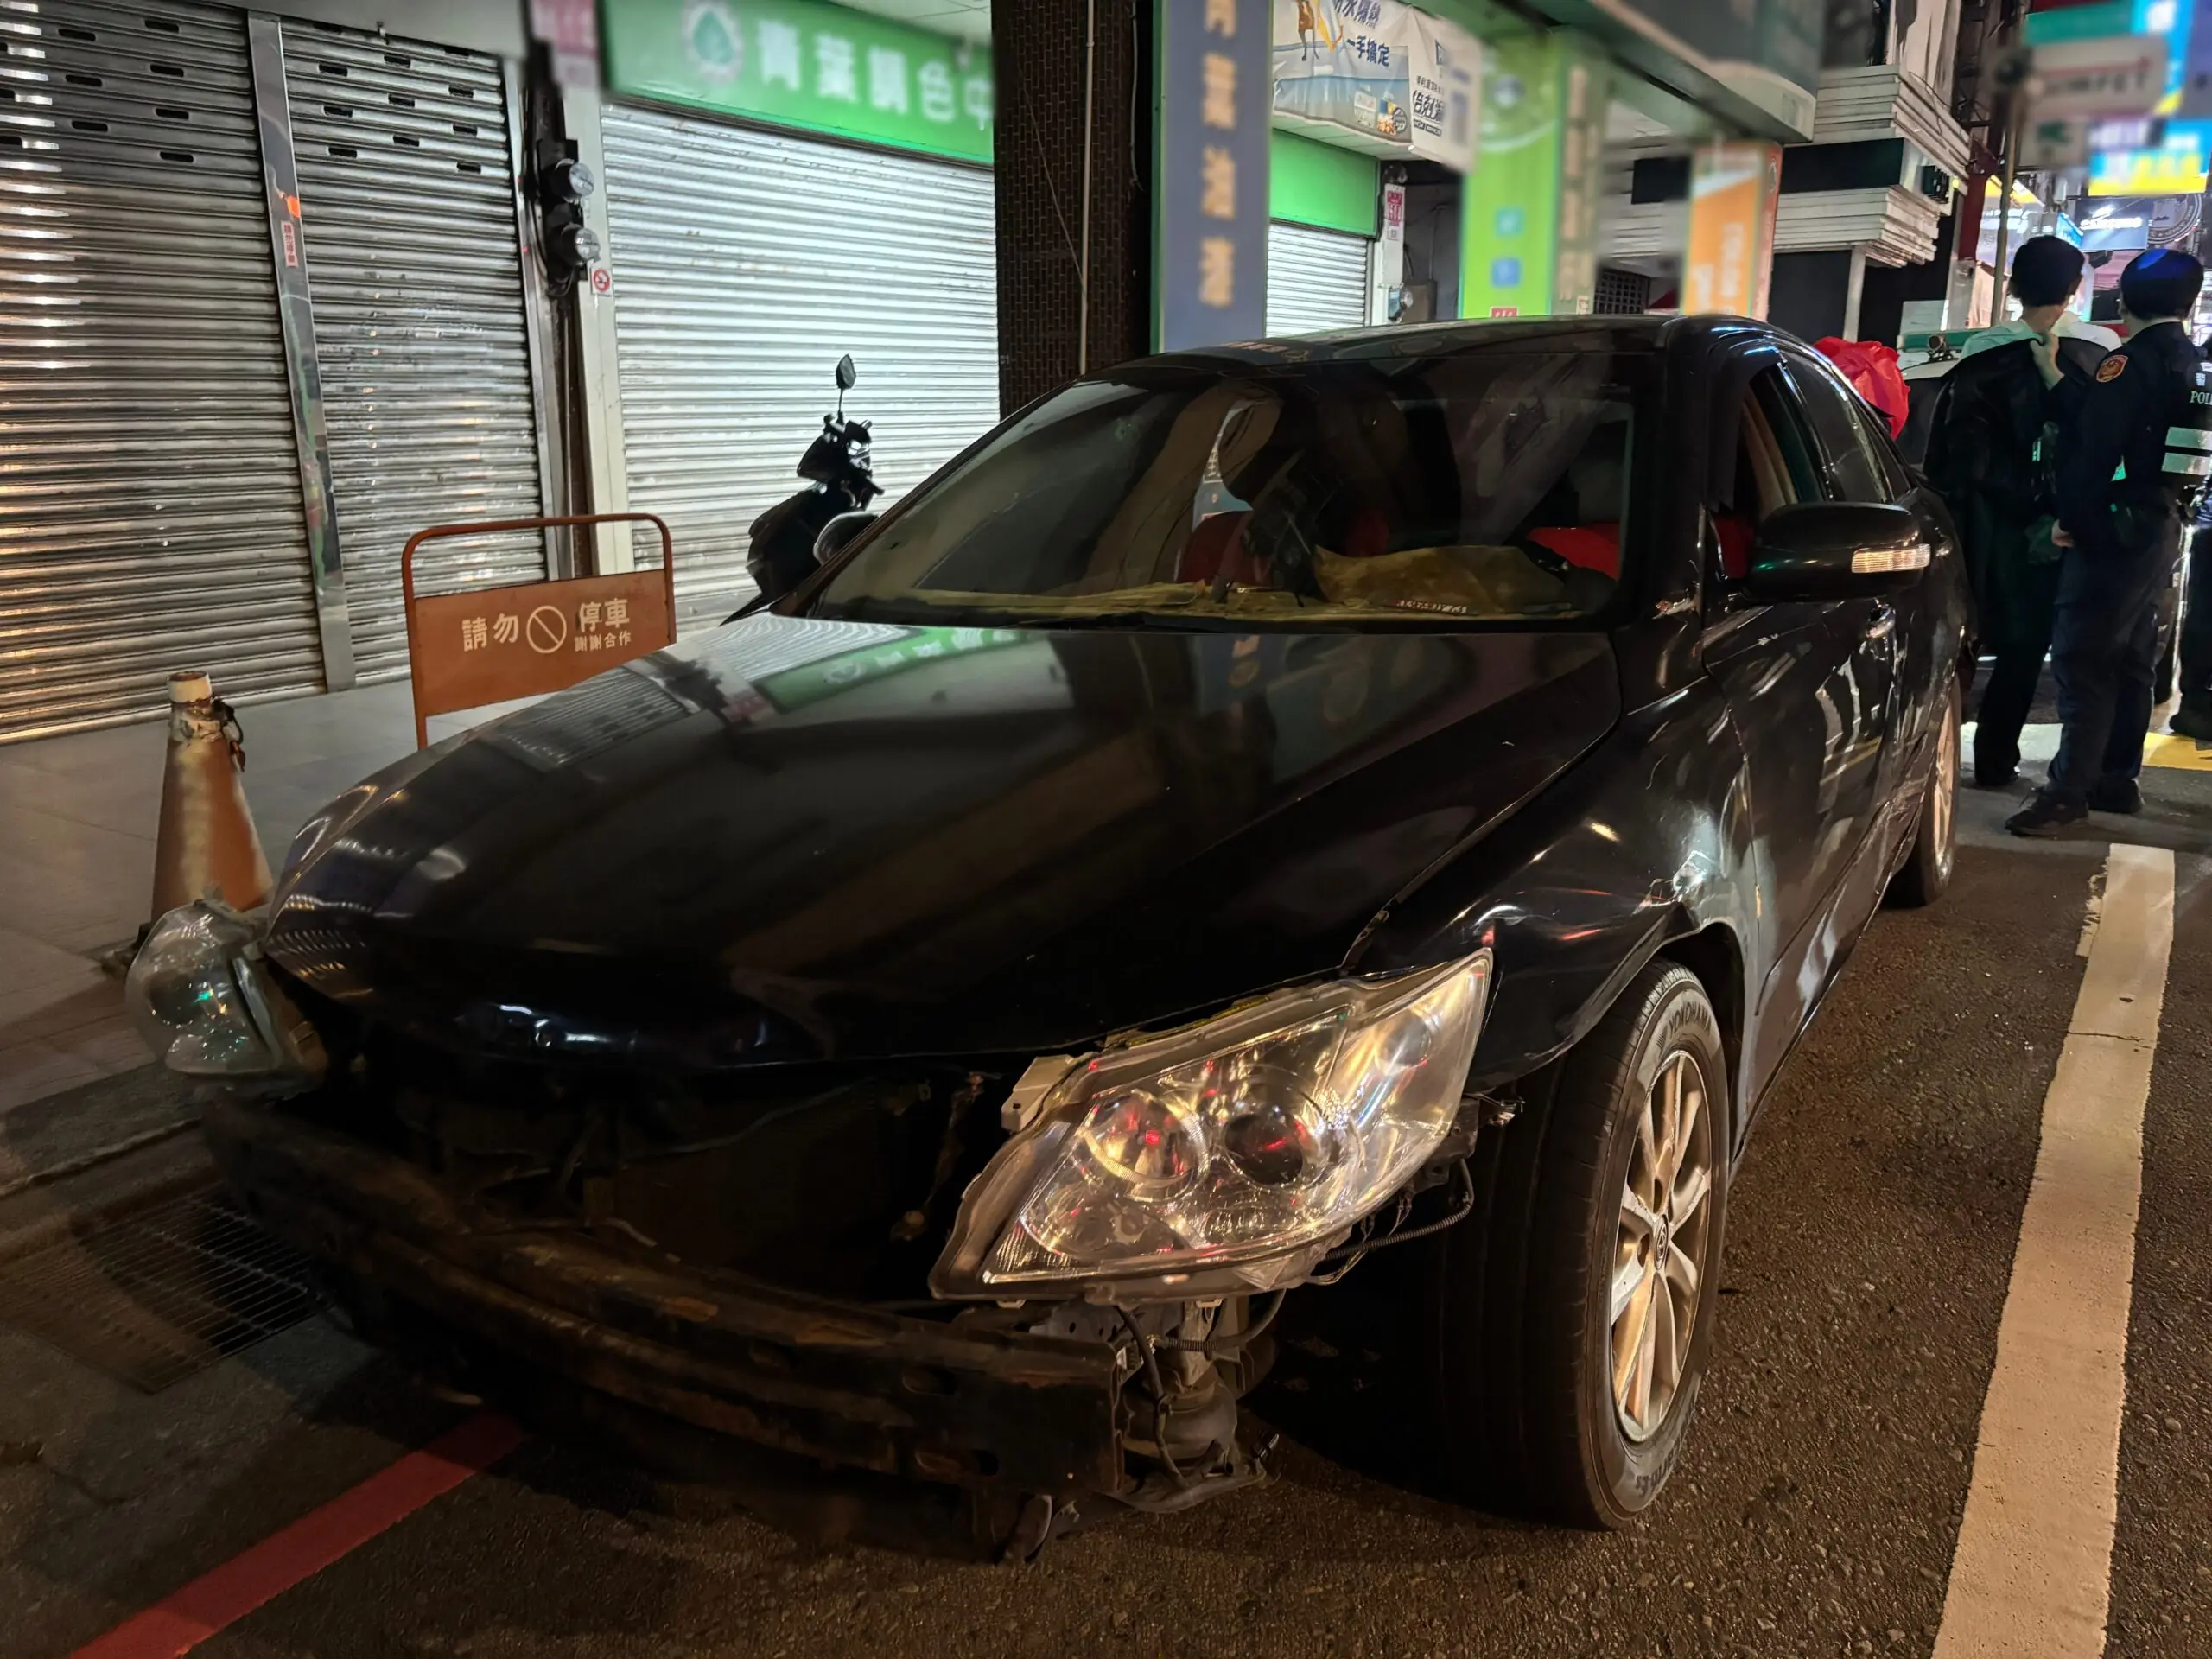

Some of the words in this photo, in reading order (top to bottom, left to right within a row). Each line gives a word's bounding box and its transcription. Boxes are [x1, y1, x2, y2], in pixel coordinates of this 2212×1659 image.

[1346, 35, 1390, 67] 一手搞定
[461, 612, 519, 652] 請勿
[578, 598, 630, 633] 停車
[574, 631, 632, 652] 謝謝合作
